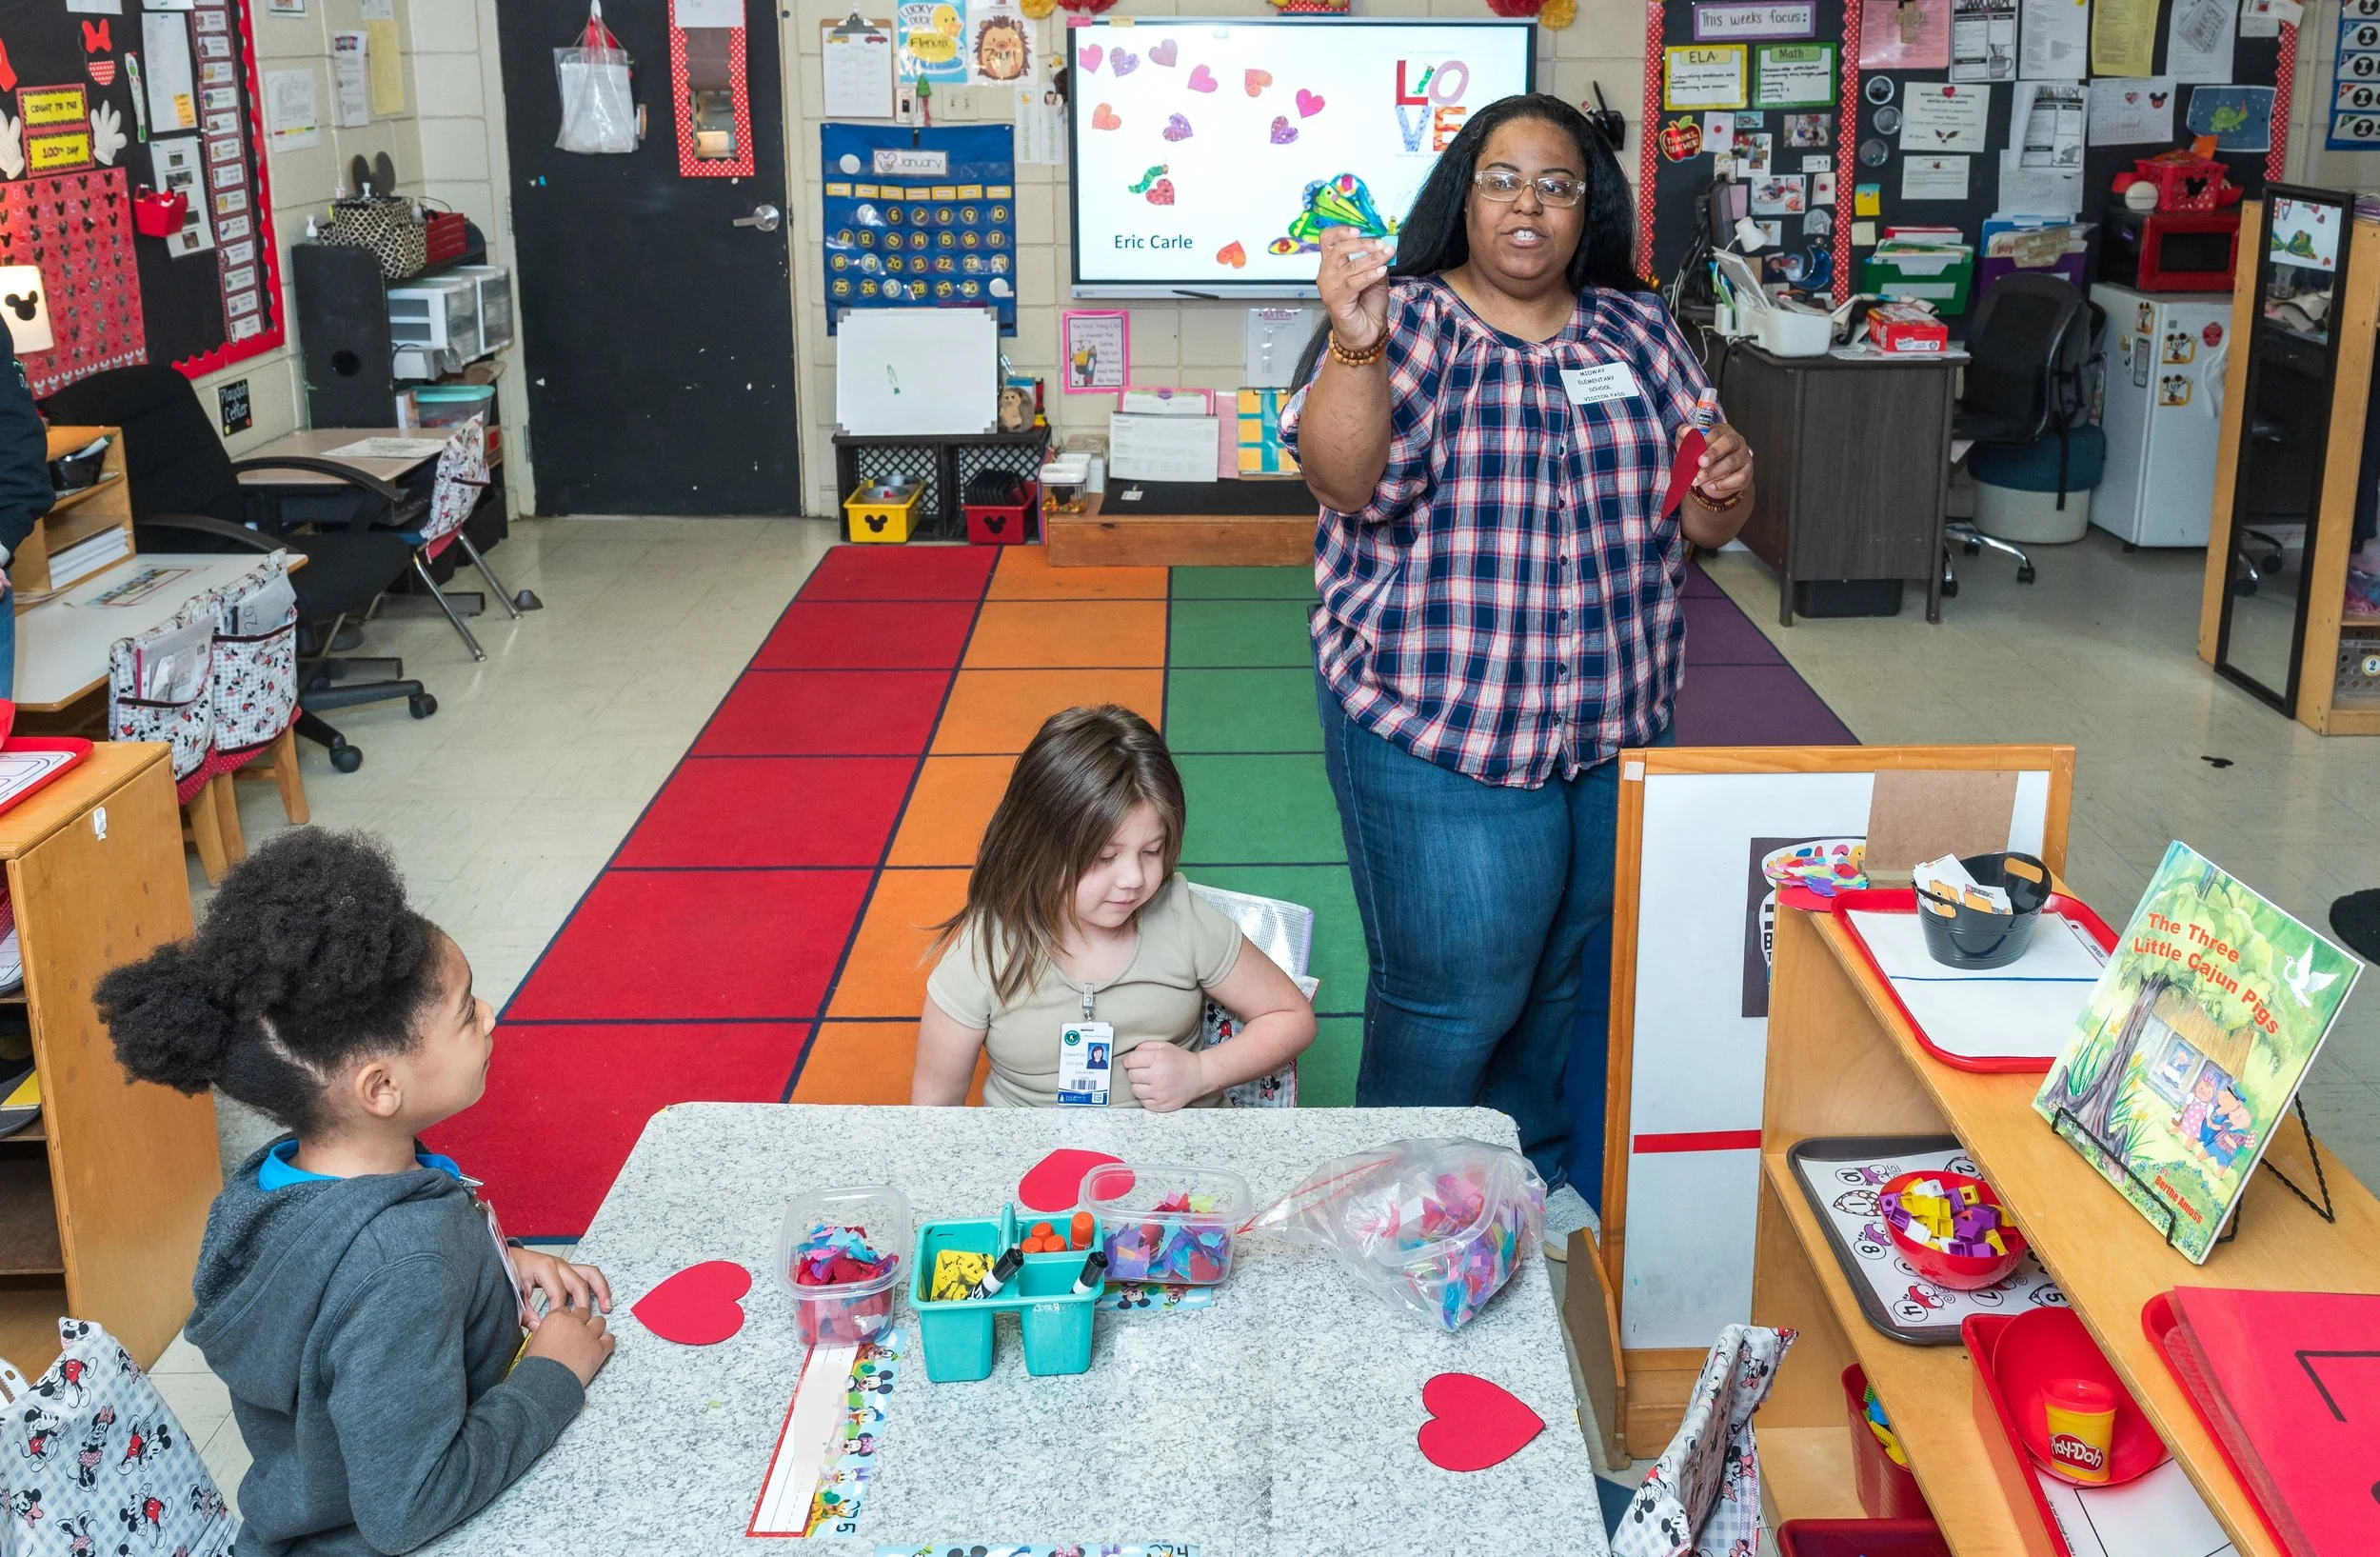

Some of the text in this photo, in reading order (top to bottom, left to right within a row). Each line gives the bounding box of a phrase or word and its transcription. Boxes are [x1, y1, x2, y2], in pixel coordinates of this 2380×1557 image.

[900, 4, 934, 18] LUCKY
[909, 15, 932, 25] DUCK
[1701, 9, 1807, 27] This weeks focus:
[30, 101, 77, 113] COUNT TO THE
[898, 158, 943, 170] January
[891, 209, 1005, 221] 6 7 8 9 10
[842, 232, 1000, 246] 11 12 13 14 15 16 17
[1115, 234, 1193, 249] Eric Carle
[835, 256, 1006, 269] 18 19 20 21 22 23 24
[835, 280, 977, 295] 25 26 27 28 29 30
[1579, 368, 1605, 376] MIDWAY
[1577, 375, 1615, 385] ELEMENTARY
[1584, 393, 1609, 402] VISITOR
[2369, 660, 2377, 670] 2
[2148, 912, 2240, 963] The Three
[2133, 937, 2279, 1035] Little Cajun Pigs
[1955, 1165, 1976, 1174] 2
[2154, 1175, 2203, 1225] Berthe Amoss
[1861, 1245, 1880, 1254] 8
[1902, 1291, 2068, 1316] 4 7 5
